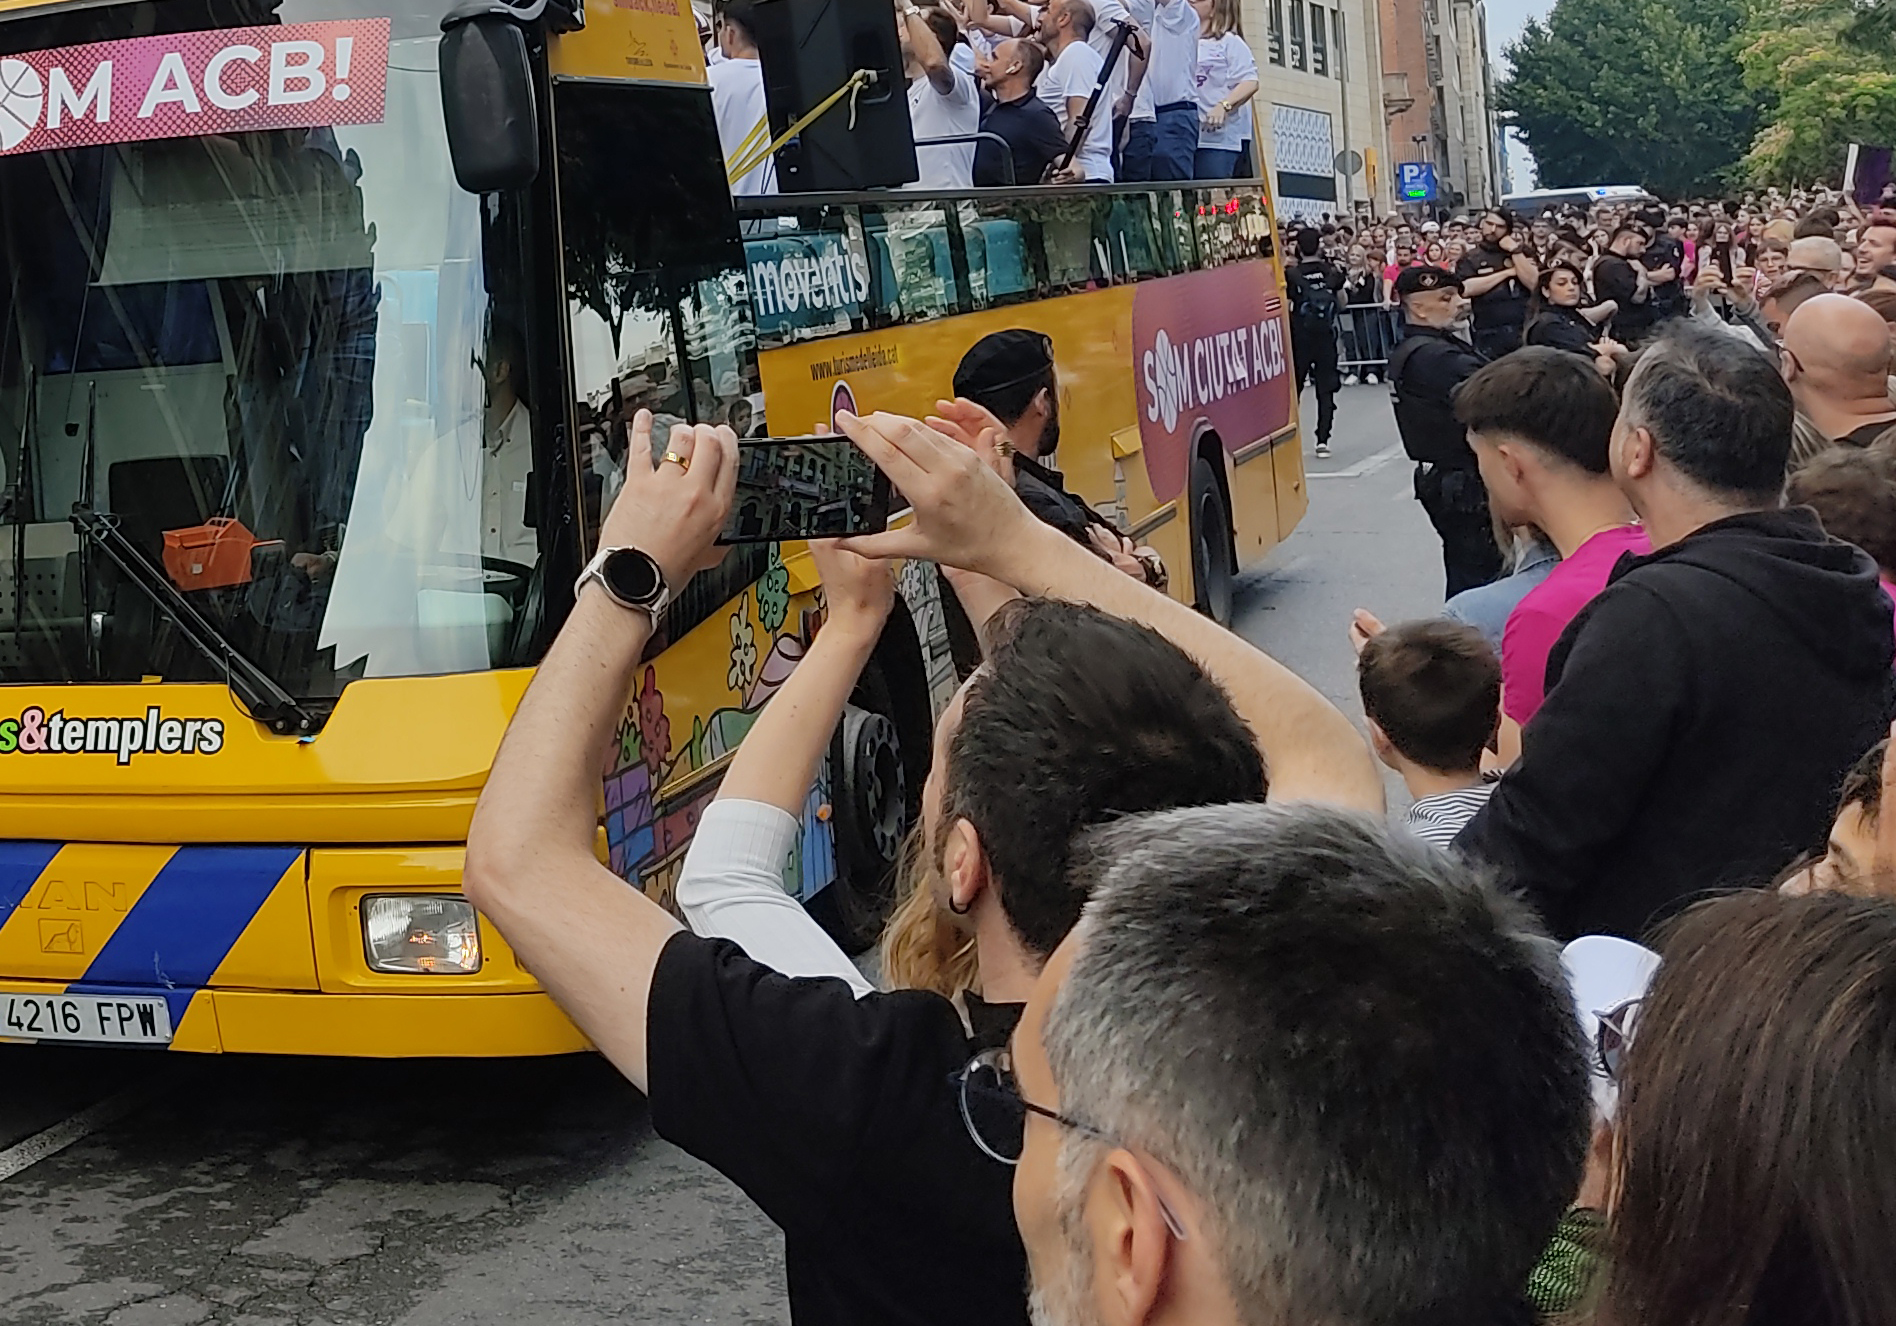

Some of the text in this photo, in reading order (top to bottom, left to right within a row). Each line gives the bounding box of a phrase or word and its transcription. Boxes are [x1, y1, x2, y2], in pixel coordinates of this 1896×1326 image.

[136, 36, 354, 120] ACB!
[1403, 164, 1420, 183] P
[752, 234, 869, 316] moventis
[1194, 327, 1248, 406] CIUTAT
[1251, 316, 1286, 385] ACB!
[6, 998, 157, 1037] 4216 FPW
